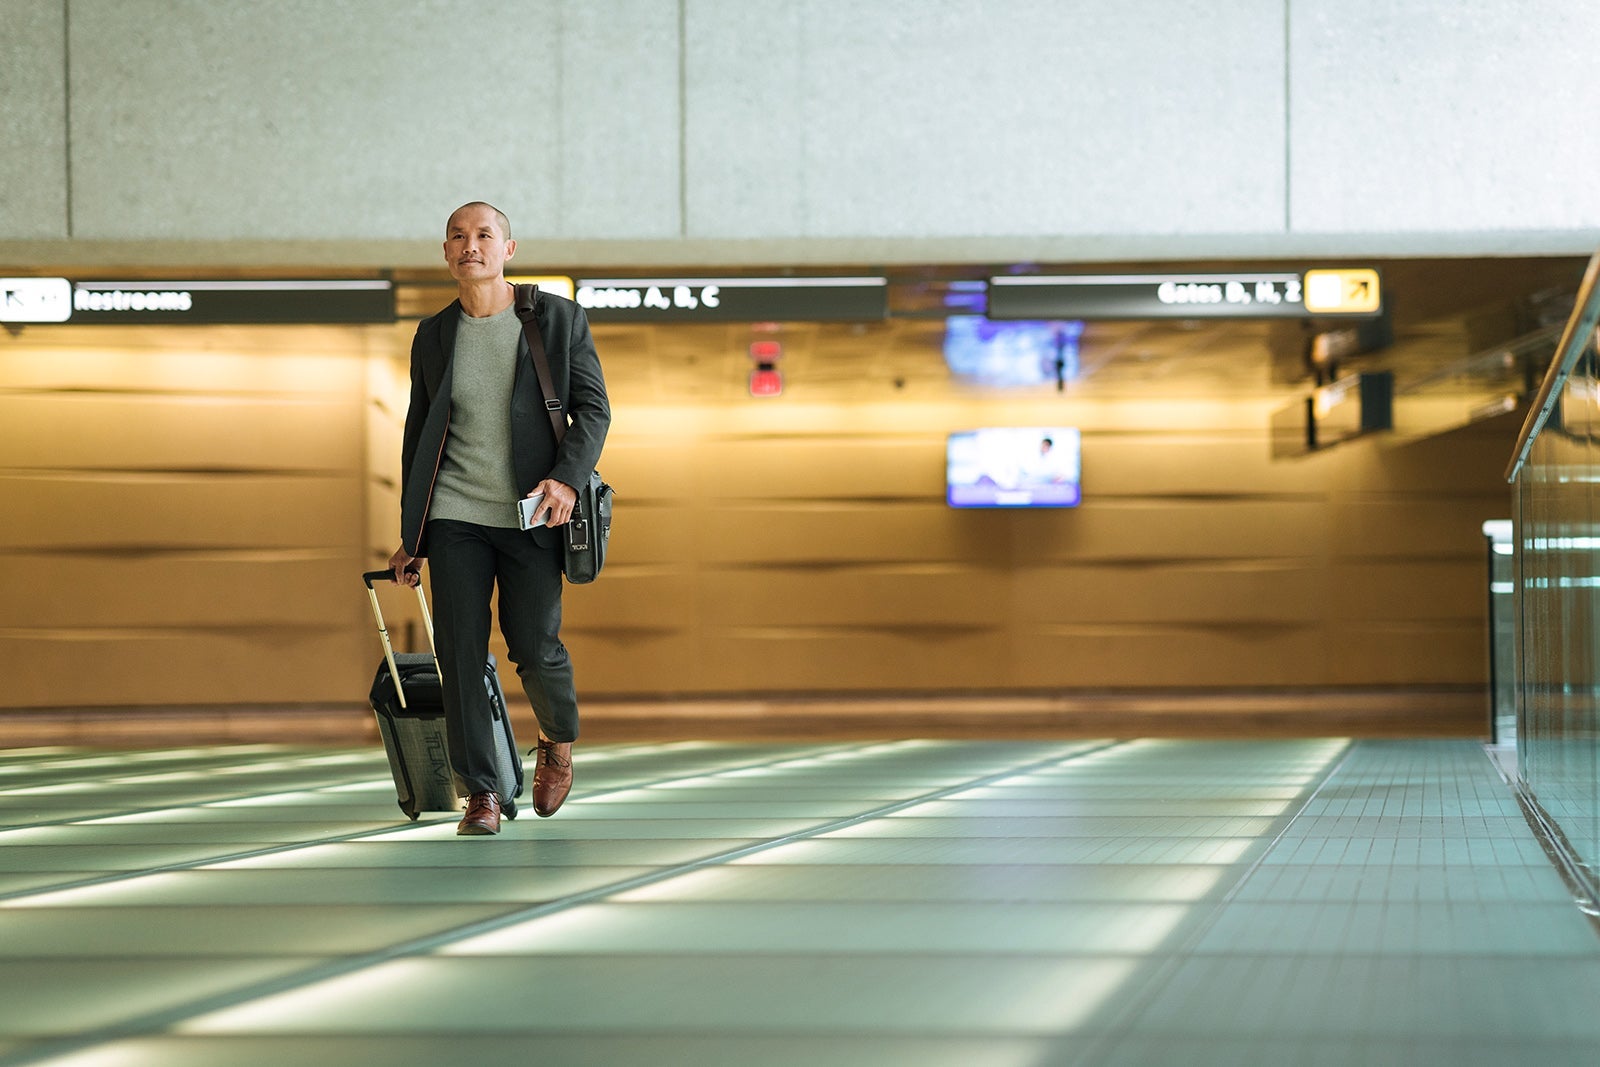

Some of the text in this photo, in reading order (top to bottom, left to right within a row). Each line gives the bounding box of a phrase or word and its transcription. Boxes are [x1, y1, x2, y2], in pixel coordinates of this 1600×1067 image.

[74, 288, 192, 310] Restrooms
[576, 286, 641, 309] Gates
[643, 286, 671, 310] A,
[701, 285, 720, 308] C
[1157, 282, 1222, 304] Gates
[424, 731, 454, 786] TUMI
